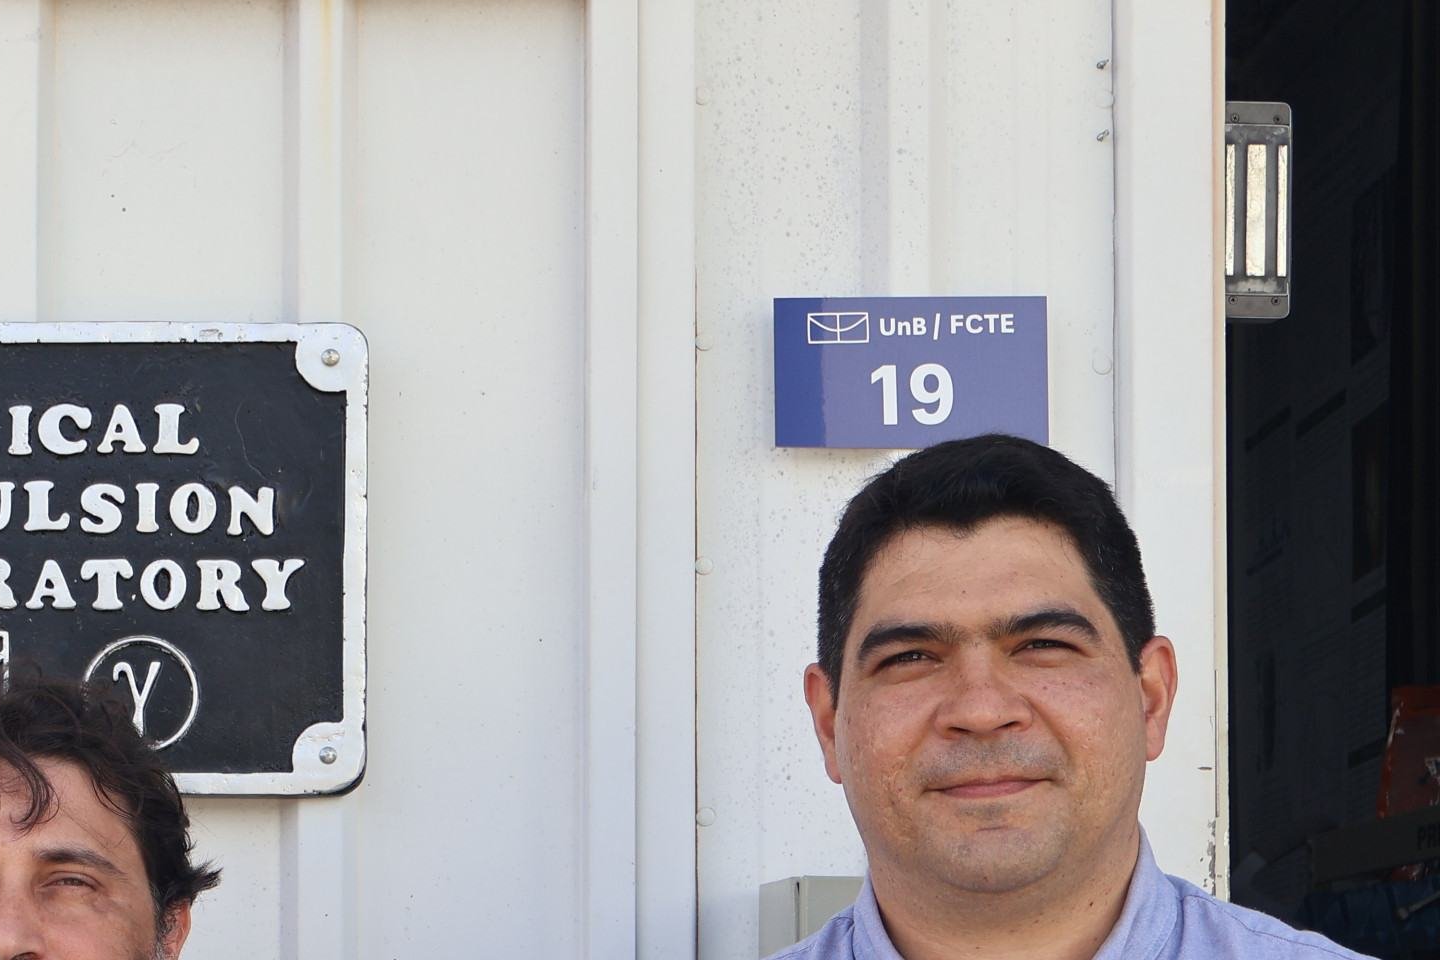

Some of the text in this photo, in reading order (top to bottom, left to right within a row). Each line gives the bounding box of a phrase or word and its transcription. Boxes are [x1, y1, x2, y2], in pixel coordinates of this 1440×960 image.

[879, 312, 1015, 341] UnB / FCTE
[870, 363, 954, 426] 19
